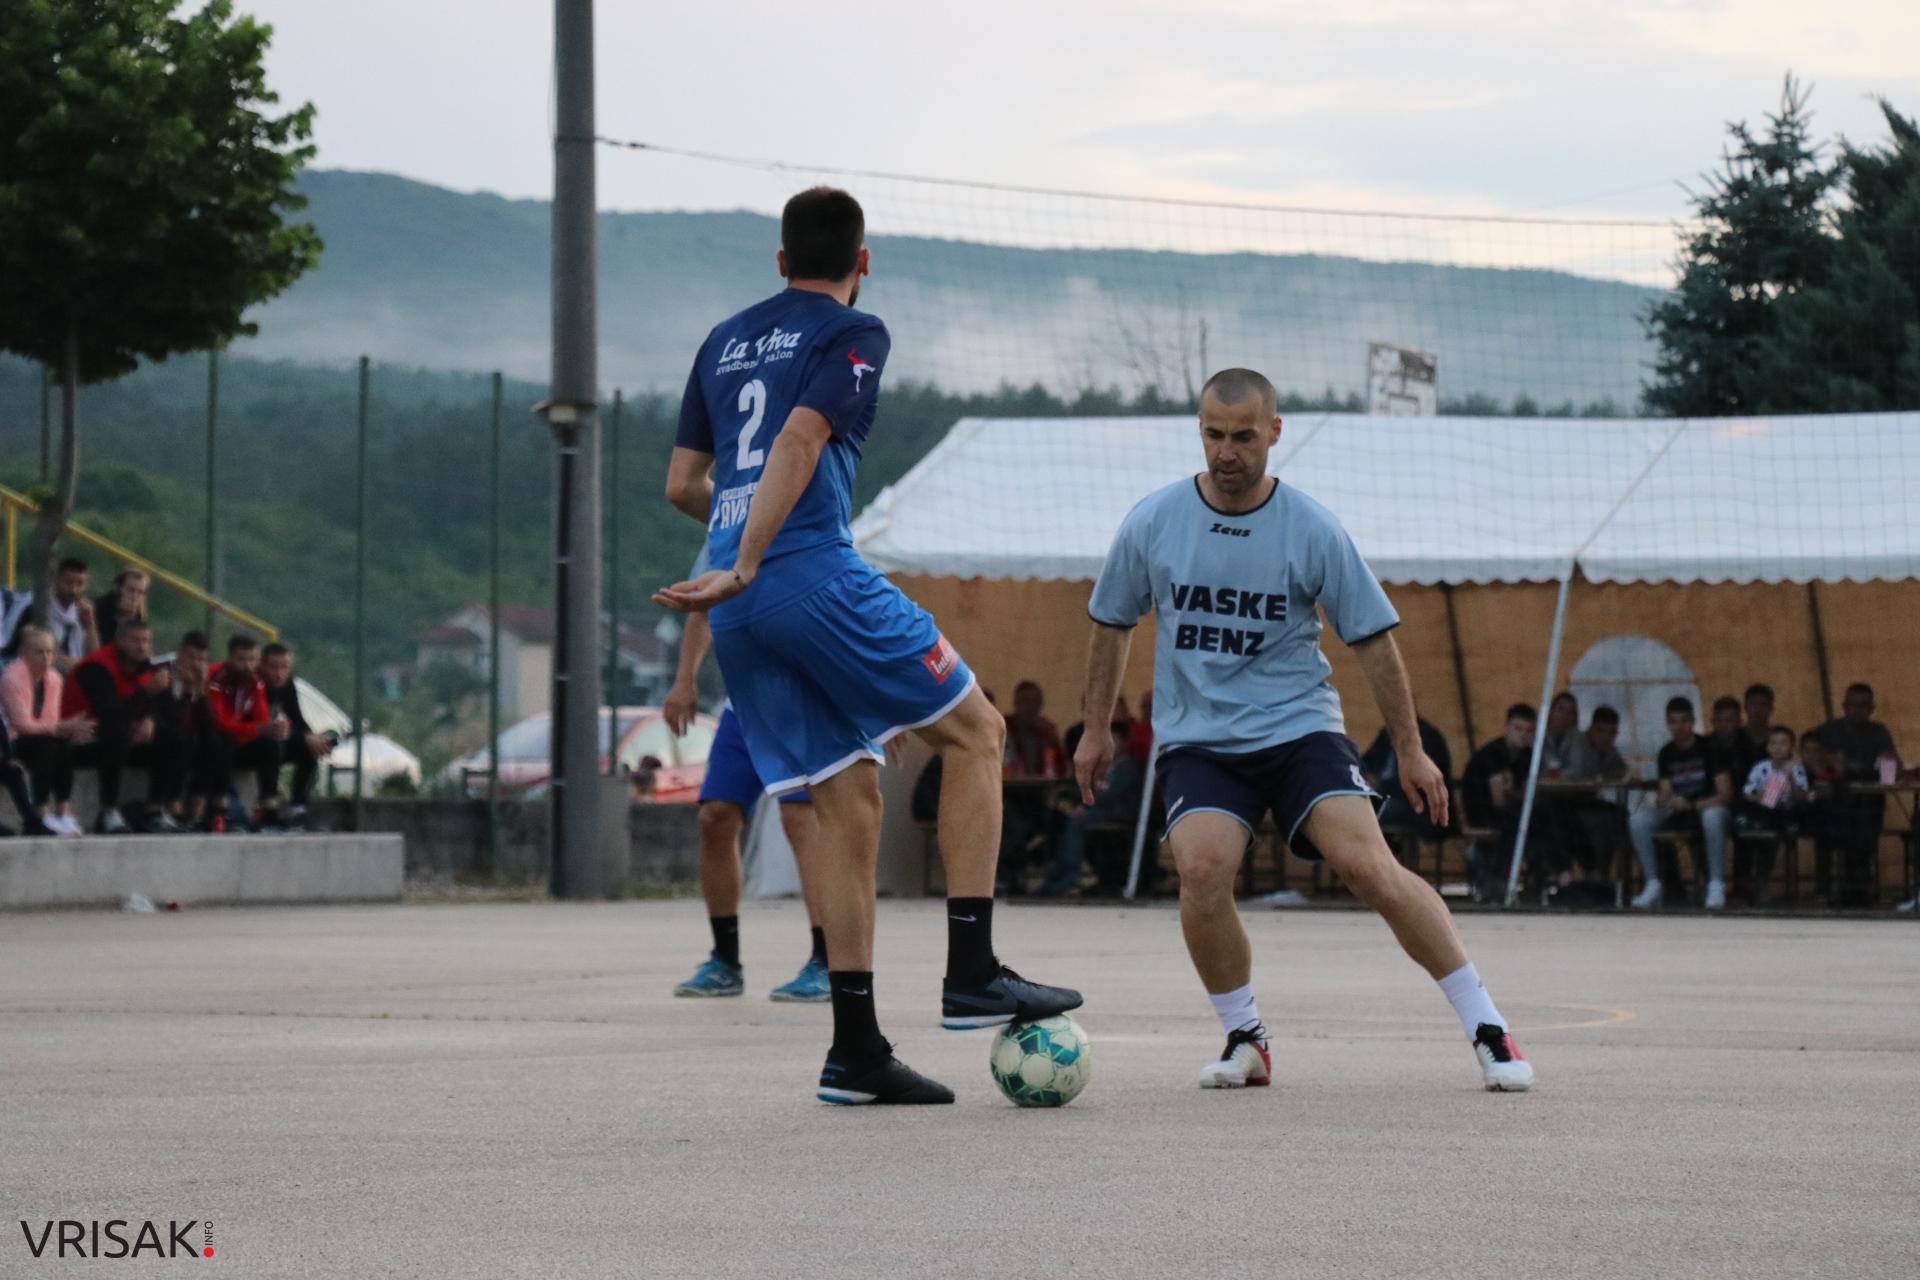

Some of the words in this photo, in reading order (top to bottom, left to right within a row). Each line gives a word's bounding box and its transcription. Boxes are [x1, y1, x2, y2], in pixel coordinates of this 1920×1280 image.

[718, 337, 749, 364] La
[755, 327, 802, 357] Viva
[764, 349, 794, 364] salon
[736, 379, 766, 470] 2
[1209, 523, 1252, 537] Zeus
[1170, 582, 1287, 622] VASKE
[1175, 624, 1265, 656] BENZ
